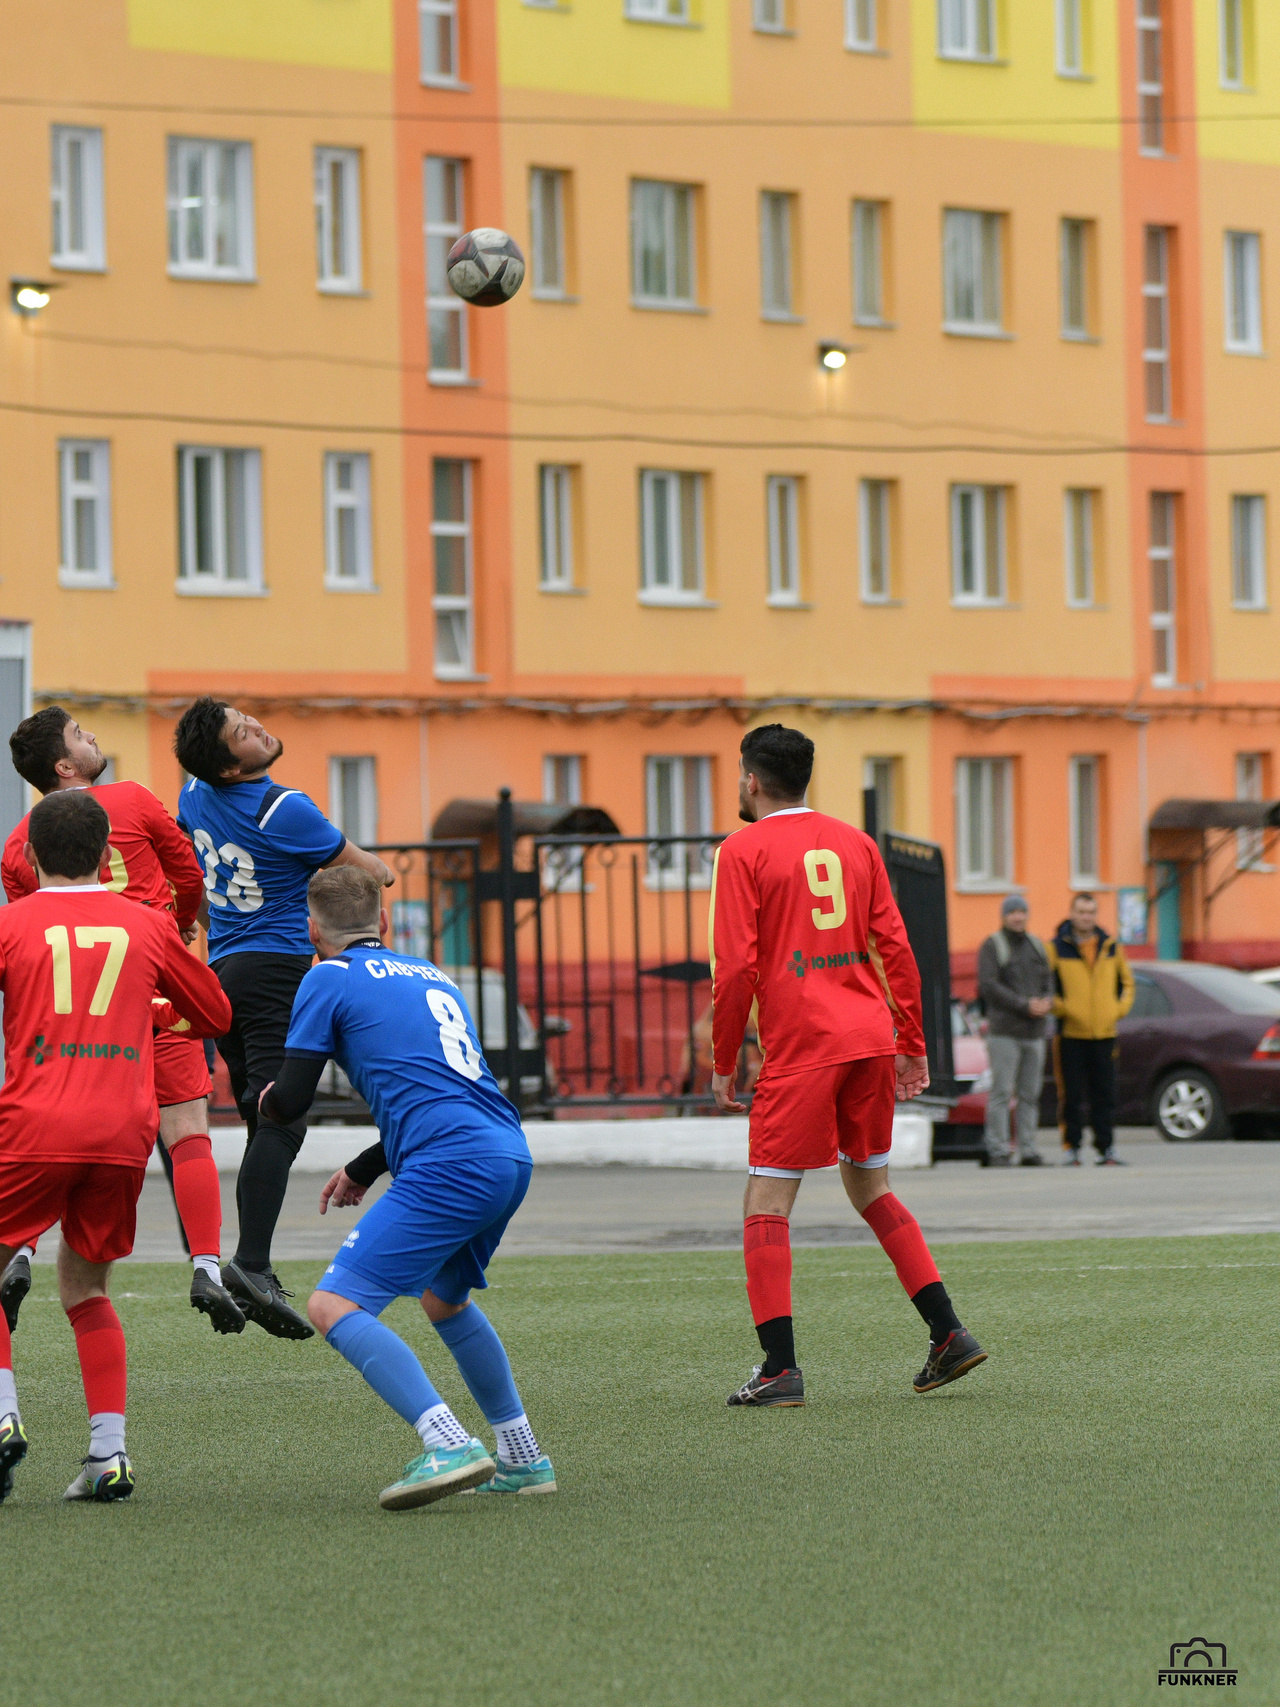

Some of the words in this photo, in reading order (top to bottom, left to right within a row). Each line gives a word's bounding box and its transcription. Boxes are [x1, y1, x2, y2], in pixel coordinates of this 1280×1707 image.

[803, 848, 847, 930] 9
[44, 925, 130, 1016] 17
[426, 988, 484, 1081] 8
